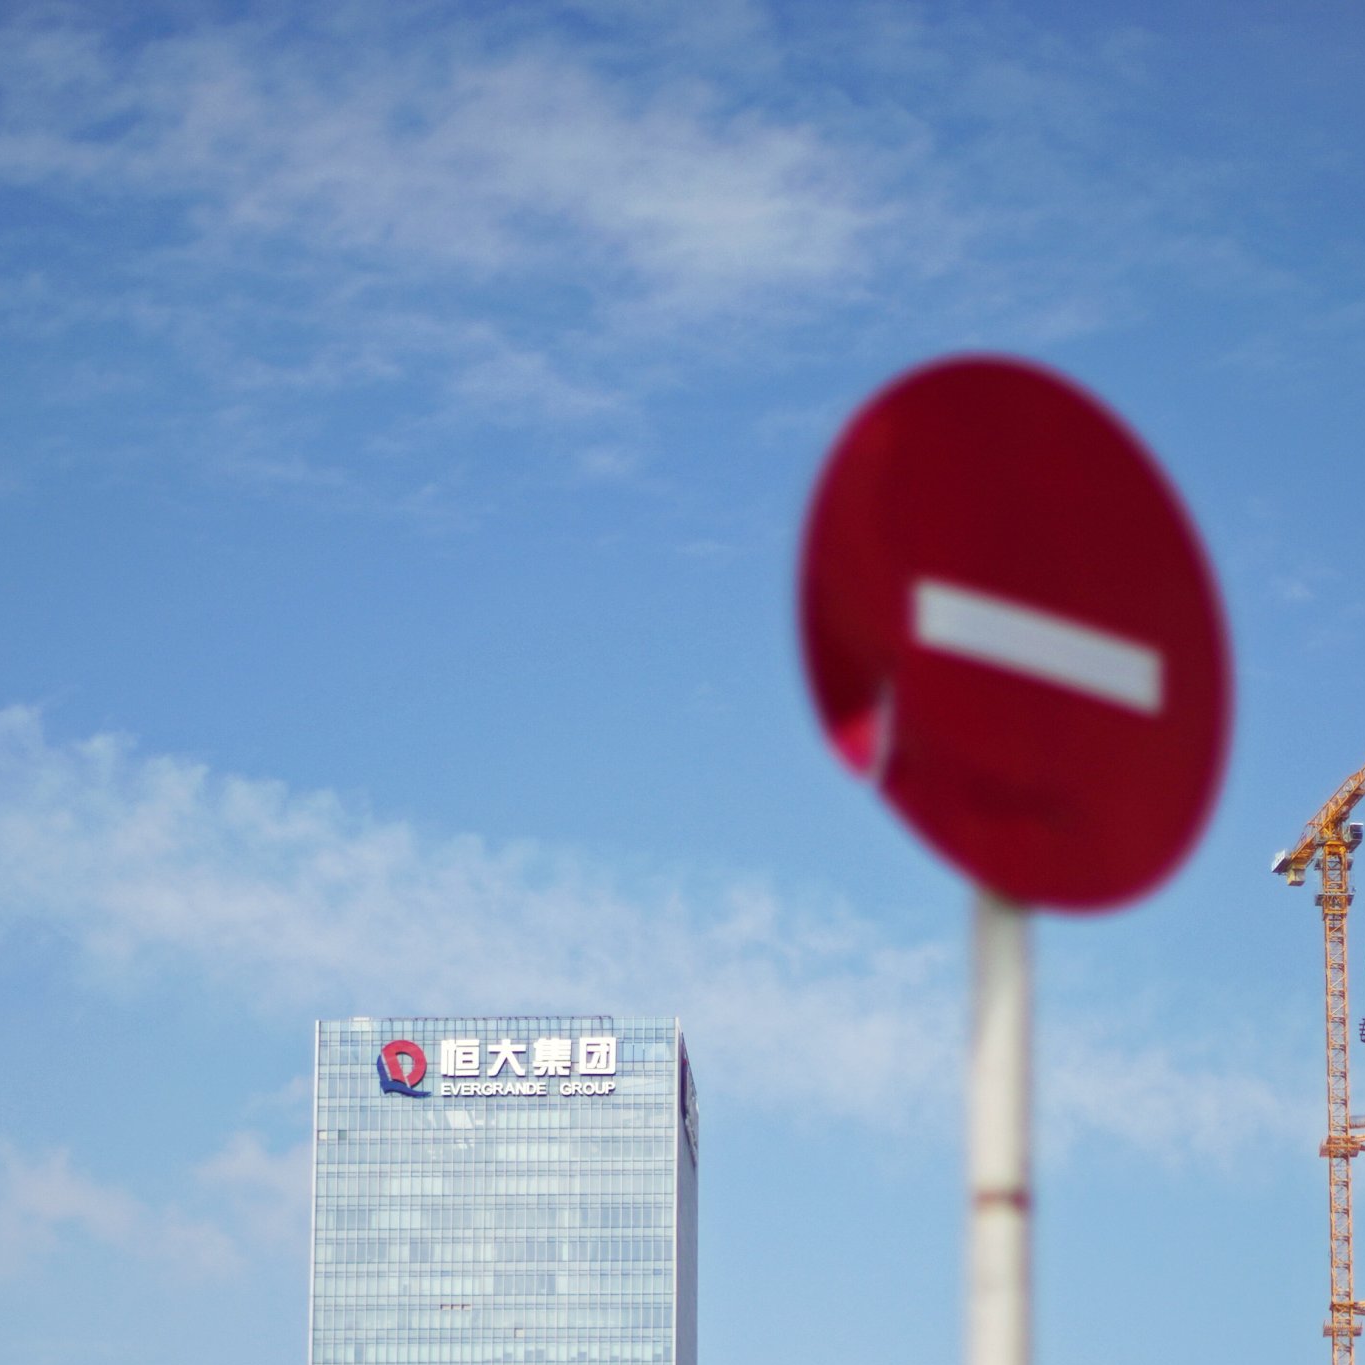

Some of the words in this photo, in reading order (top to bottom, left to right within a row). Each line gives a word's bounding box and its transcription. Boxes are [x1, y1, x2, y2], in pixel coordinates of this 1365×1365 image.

[440, 1036, 616, 1077] 恒大集团
[440, 1081, 547, 1096] EVERGRANDE
[559, 1081, 616, 1096] GROUP
